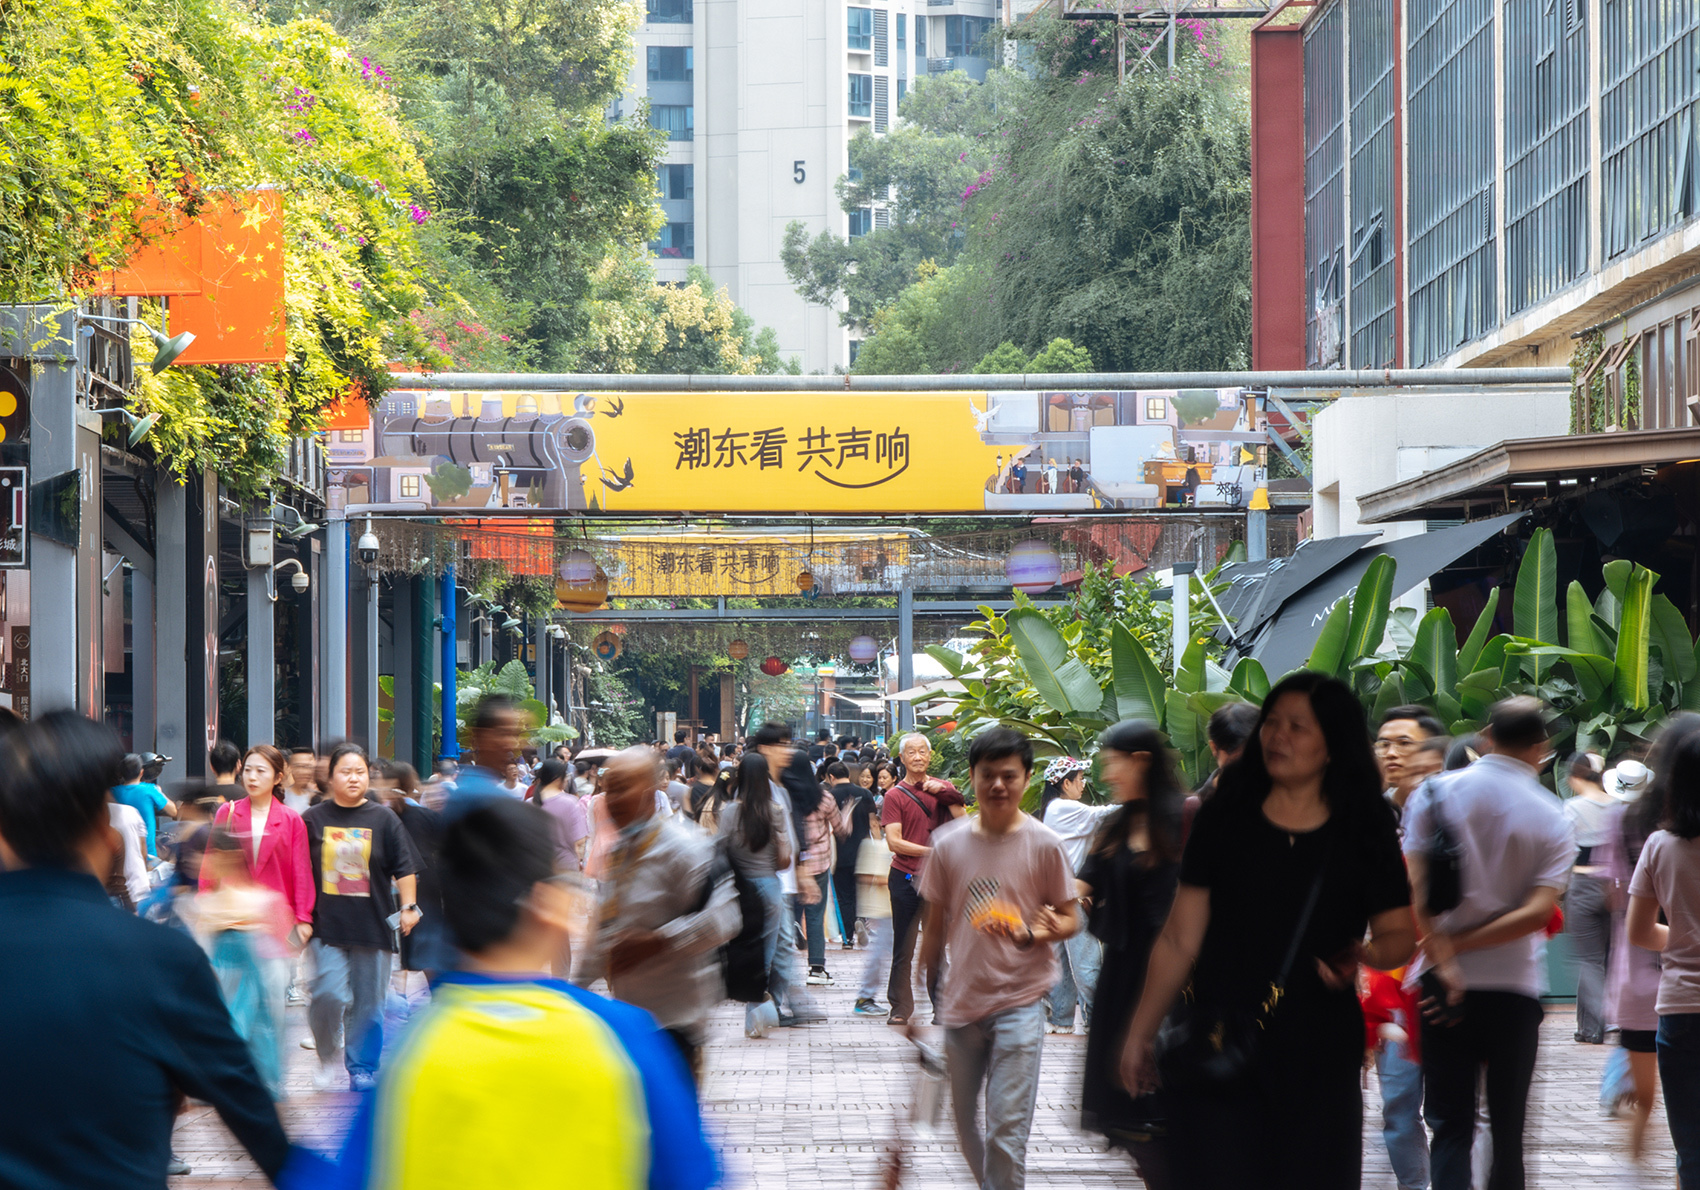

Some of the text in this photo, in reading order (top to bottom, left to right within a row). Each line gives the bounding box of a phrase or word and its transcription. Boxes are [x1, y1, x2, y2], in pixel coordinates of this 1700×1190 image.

[793, 160, 806, 184] 5
[673, 426, 910, 489] 潮东看 共声响
[655, 551, 780, 584] 潮东看 共声响
